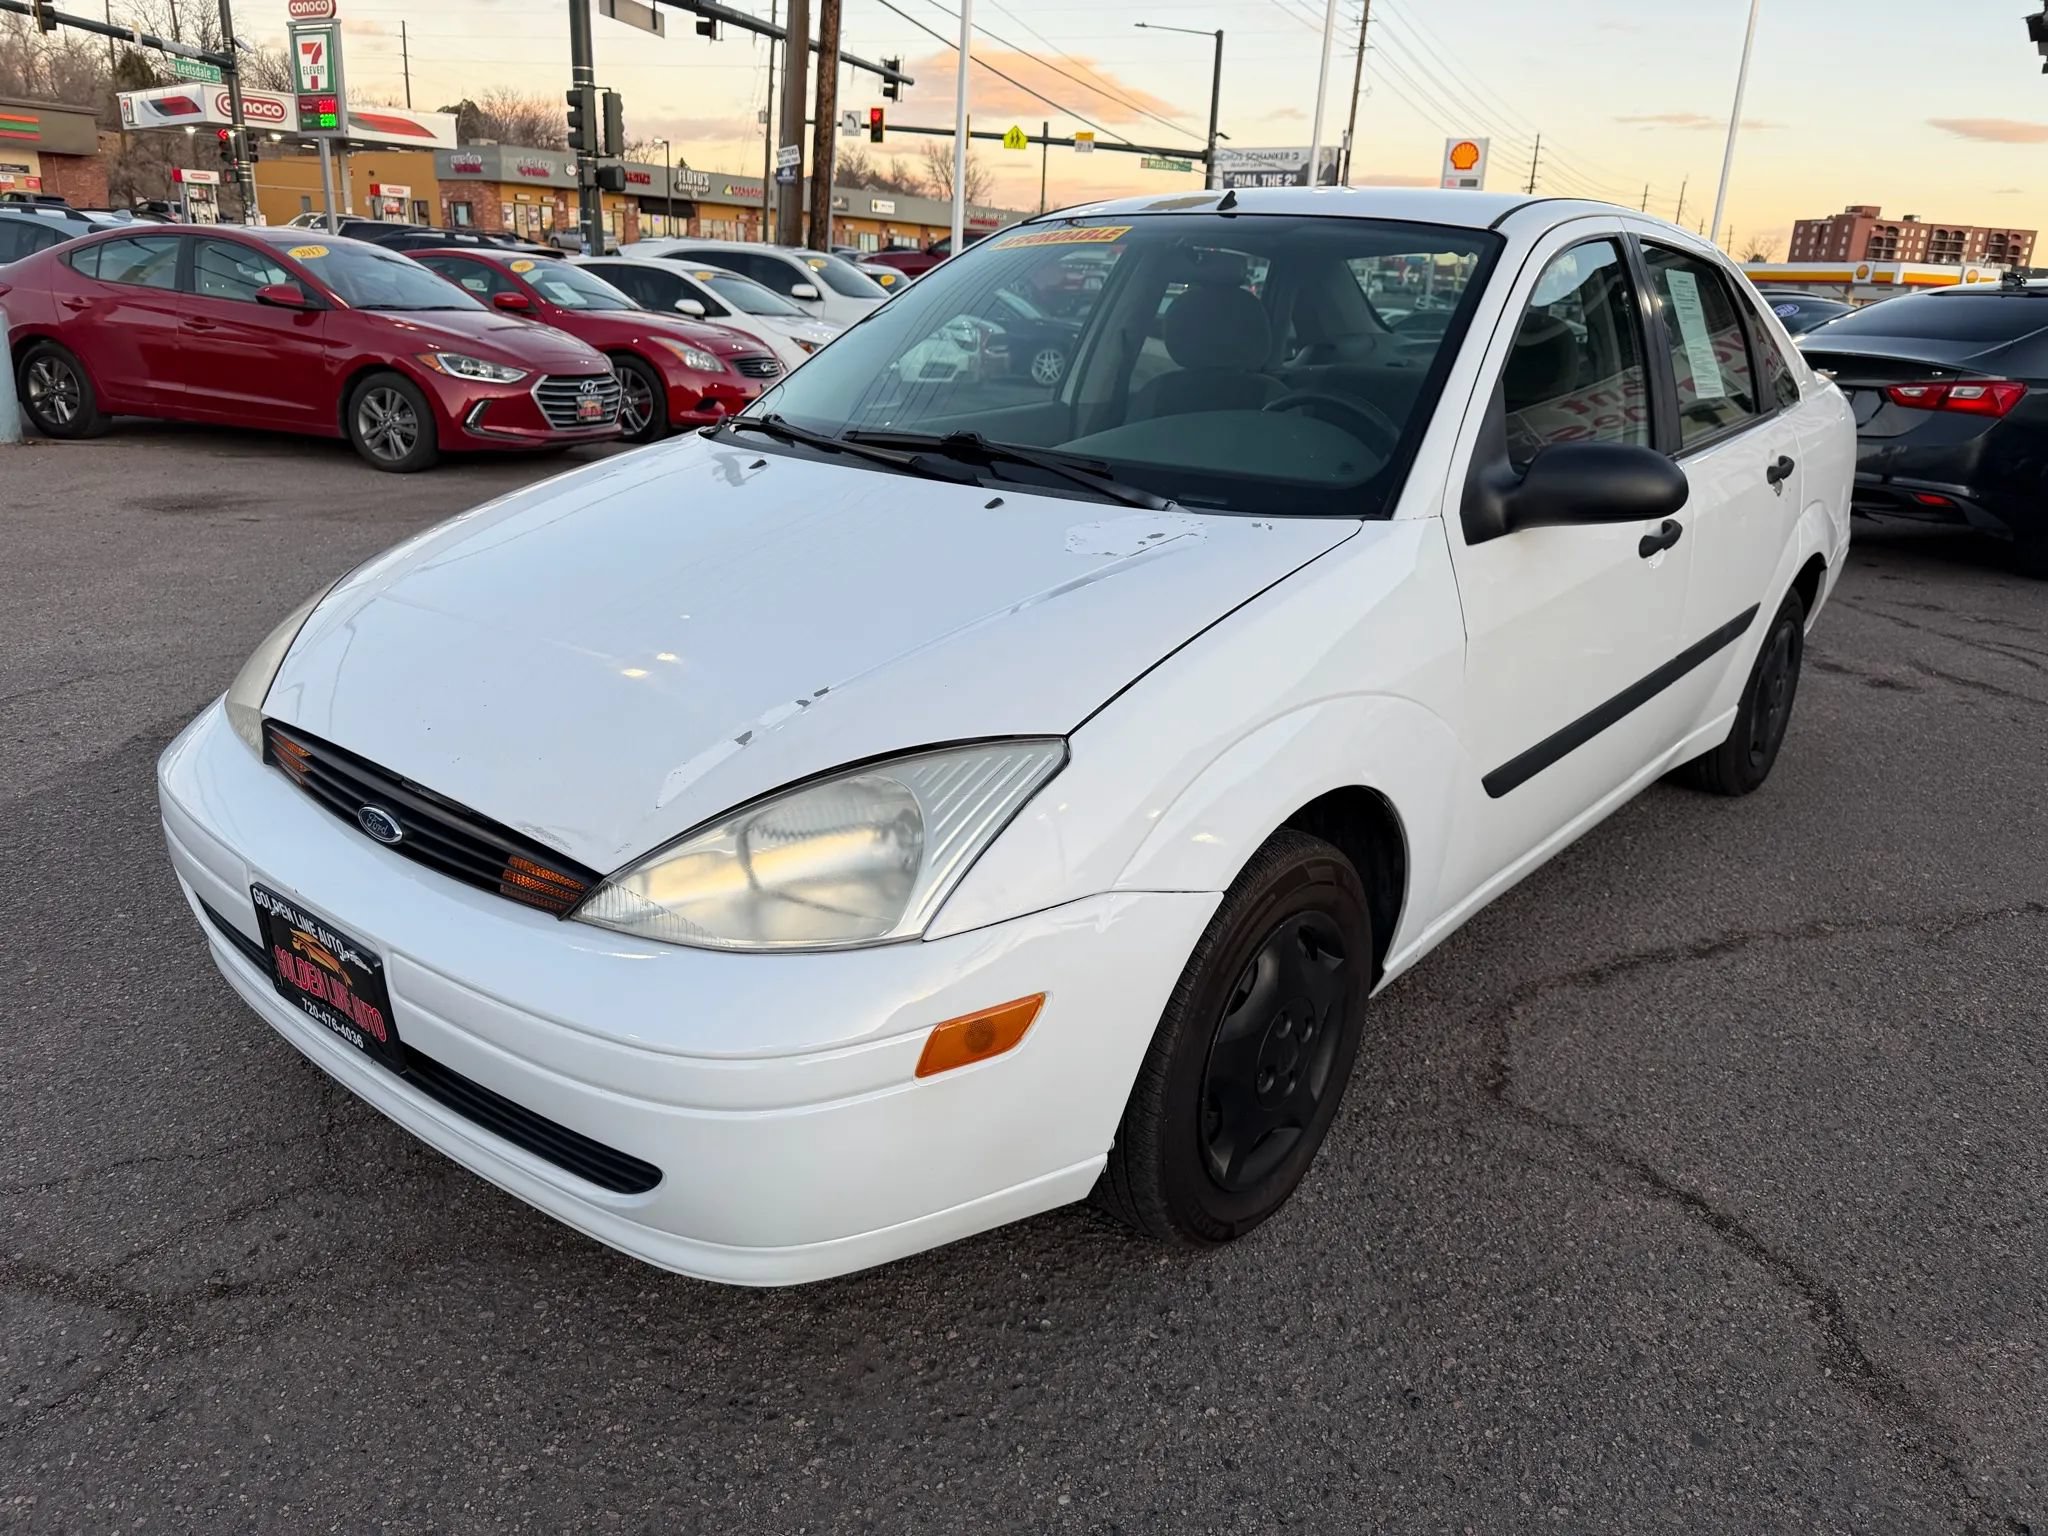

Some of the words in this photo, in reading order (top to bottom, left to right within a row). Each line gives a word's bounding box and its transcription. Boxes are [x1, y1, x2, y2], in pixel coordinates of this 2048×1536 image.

[176, 61, 212, 79] Leetsdale
[1234, 173, 1259, 187] DIAL
[1261, 173, 1283, 187] THE
[993, 228, 1127, 249] AFFORDABLE
[367, 812, 389, 836] Ford
[252, 887, 296, 924] GOLDEN
[292, 910, 319, 940] LINE
[317, 926, 344, 958] AUTO
[274, 944, 329, 1001] GOLDEN
[350, 992, 387, 1043] AUTO
[301, 996, 364, 1049] 720-476-4036
